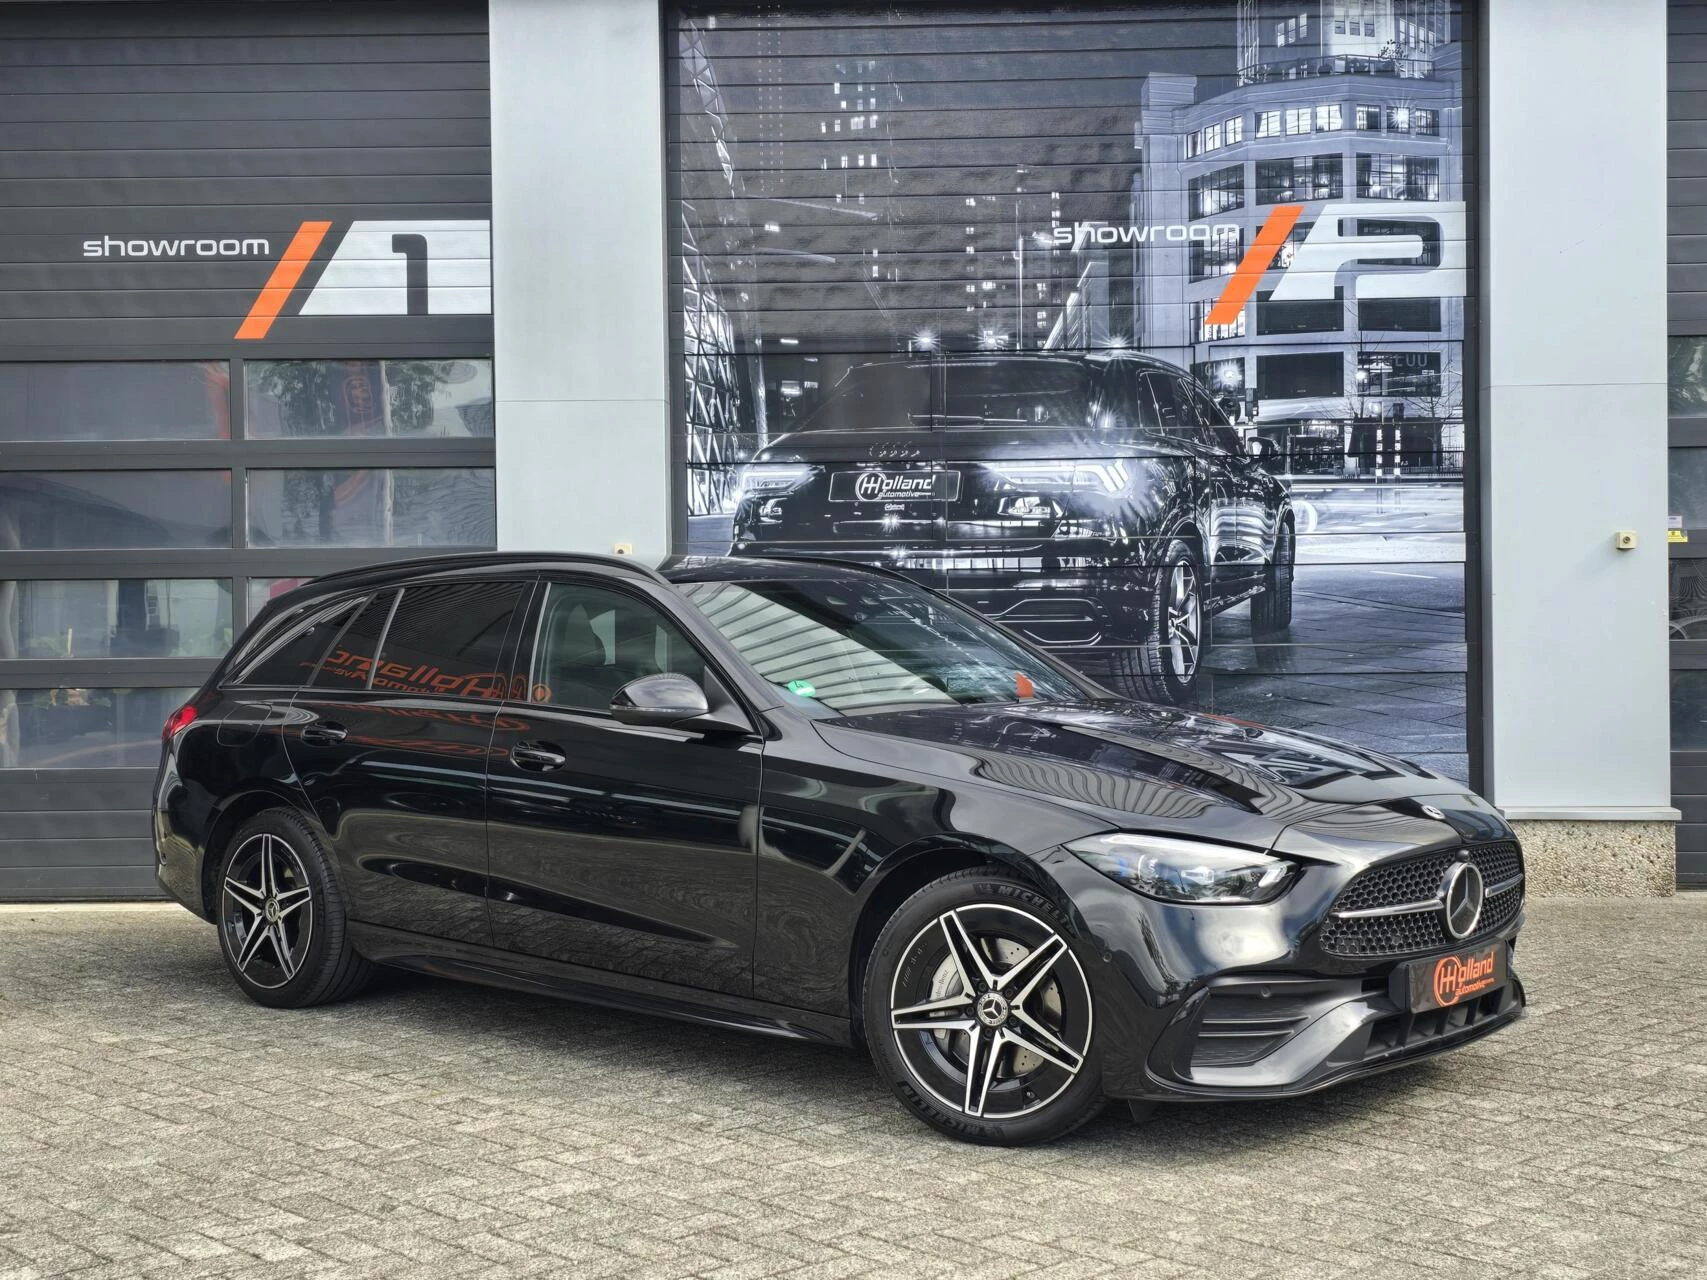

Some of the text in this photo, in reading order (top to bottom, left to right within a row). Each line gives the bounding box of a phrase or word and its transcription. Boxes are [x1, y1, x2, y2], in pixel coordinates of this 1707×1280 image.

[1053, 223, 1240, 244] showroom
[83, 233, 429, 315] showroom 1
[858, 473, 936, 495] Holland
[1435, 952, 1494, 998] Holland
